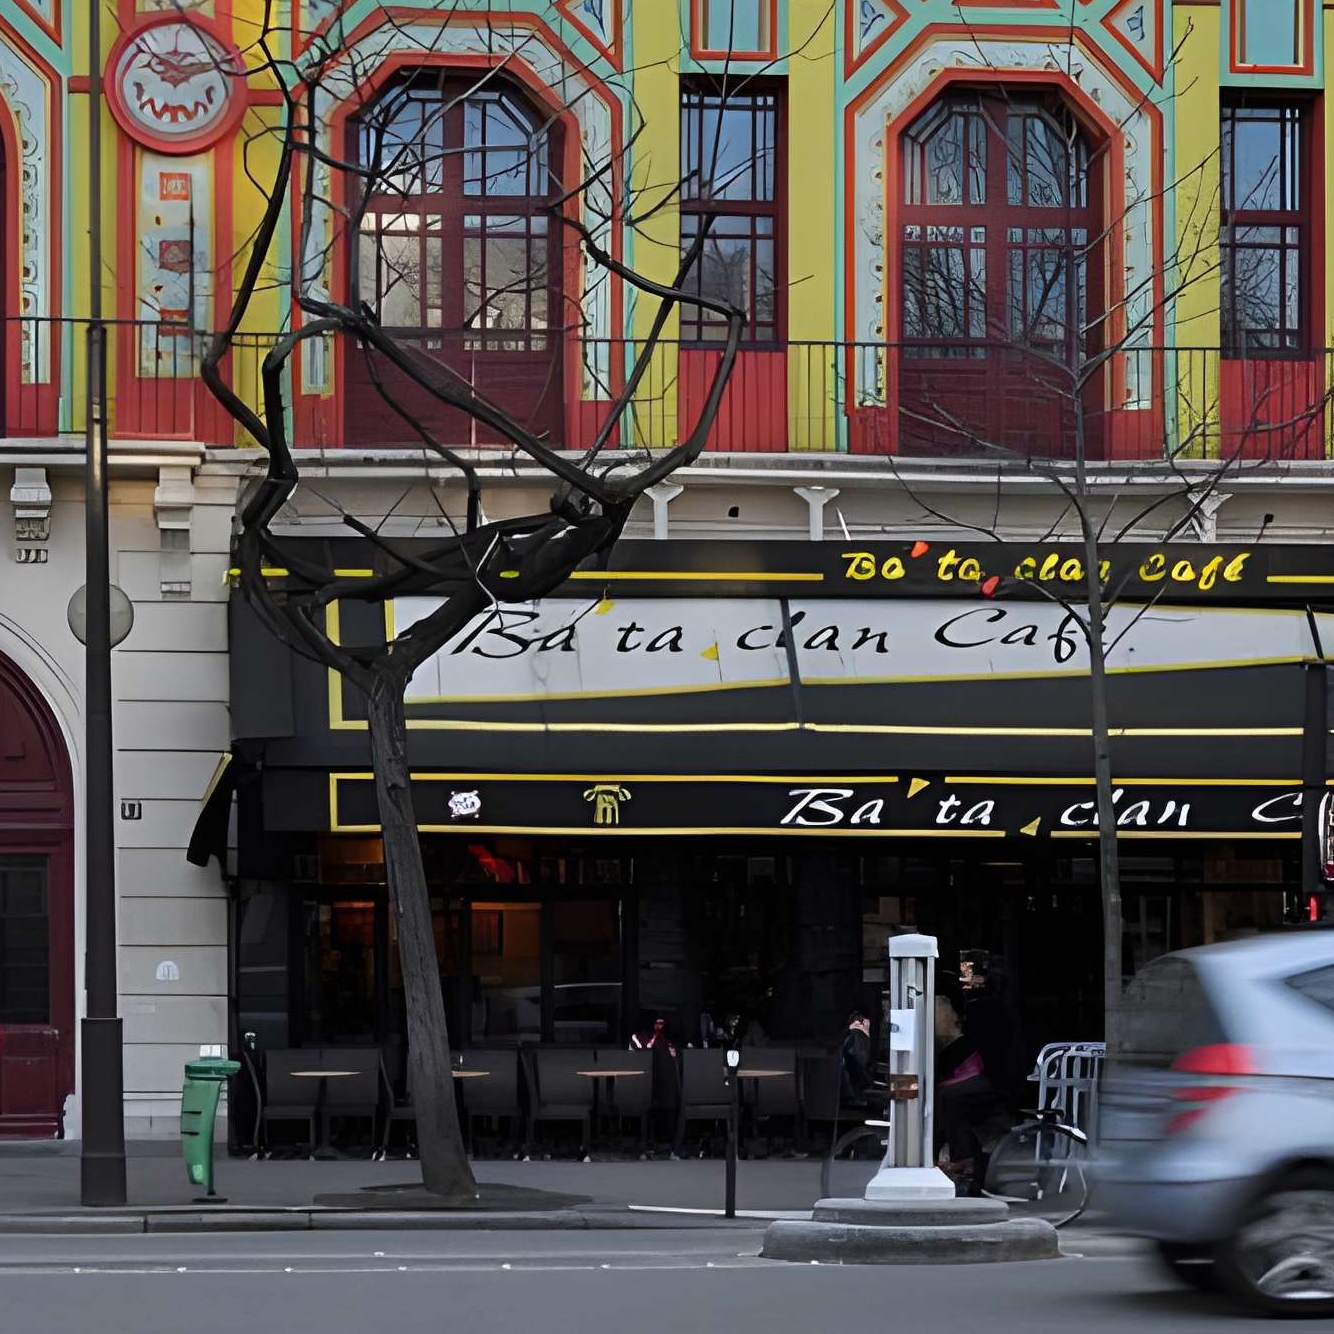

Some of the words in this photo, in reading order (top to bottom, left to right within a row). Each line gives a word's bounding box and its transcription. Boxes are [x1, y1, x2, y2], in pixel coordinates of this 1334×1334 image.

[616, 621, 684, 653] ta
[933, 607, 1108, 664] Caf
[934, 793, 996, 827] ta
